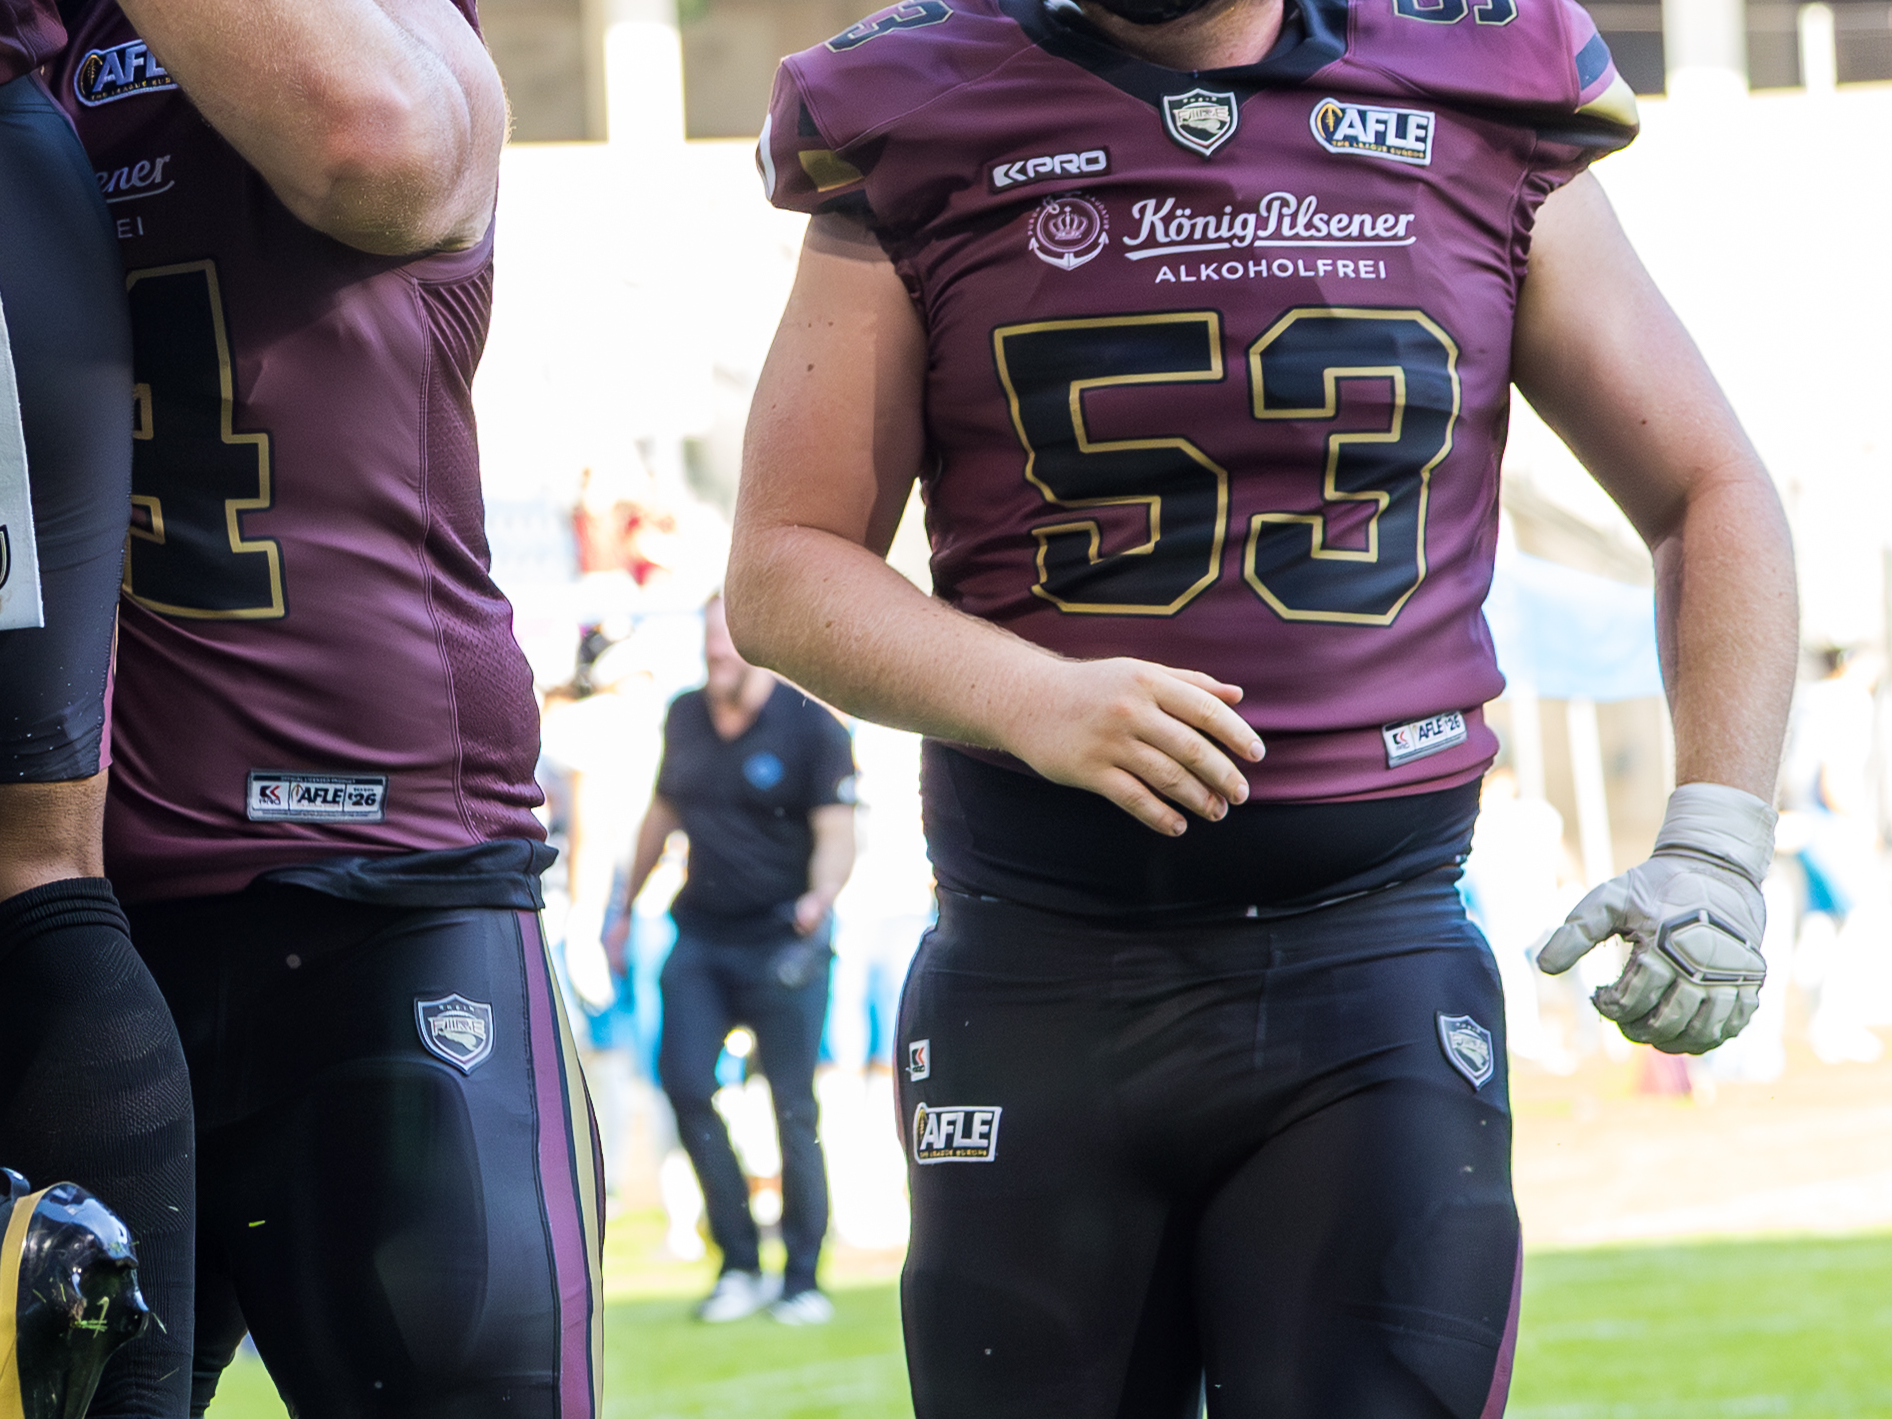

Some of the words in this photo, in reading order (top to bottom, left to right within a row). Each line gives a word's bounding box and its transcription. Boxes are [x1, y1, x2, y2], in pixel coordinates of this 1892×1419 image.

[92, 43, 169, 93] AFL
[1333, 108, 1428, 152] AFLE
[1255, 191, 1416, 238] Pilsener
[1154, 258, 1387, 284] ALKOHOLFREI
[991, 304, 1462, 627] 53
[1418, 719, 1444, 742] AFLE
[297, 786, 343, 805] AFLE
[347, 792, 376, 806] '26
[920, 1111, 993, 1150] AFLE
